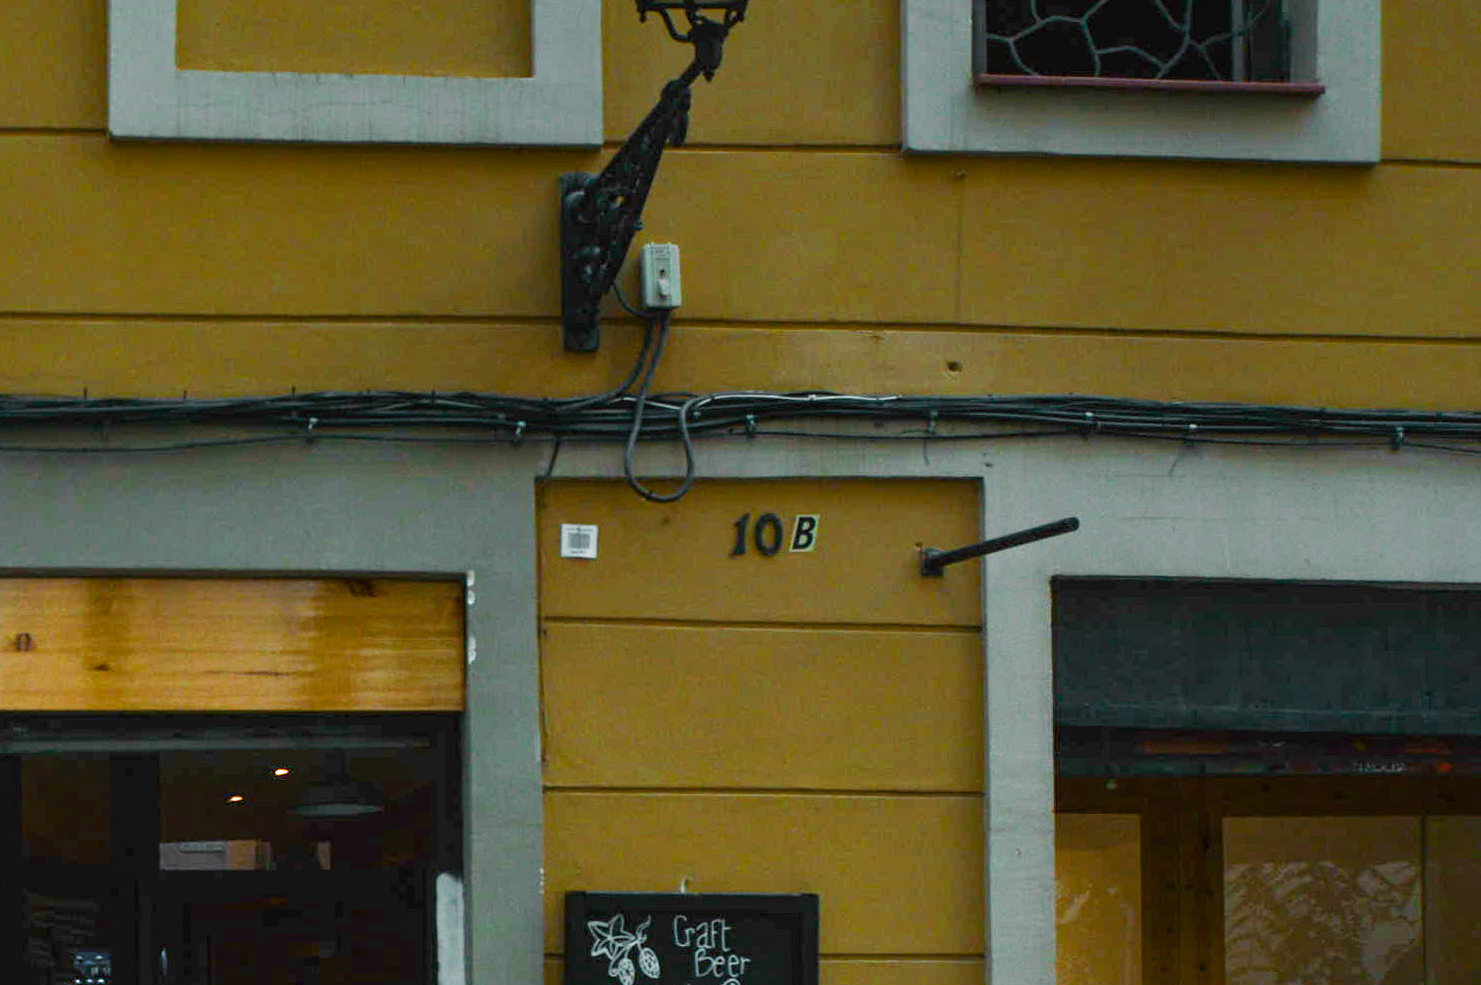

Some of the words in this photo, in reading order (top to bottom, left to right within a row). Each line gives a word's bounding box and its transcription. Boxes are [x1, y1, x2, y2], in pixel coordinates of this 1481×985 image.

[729, 513, 783, 557] 10
[791, 515, 817, 551] B
[695, 948, 750, 978] Beer
